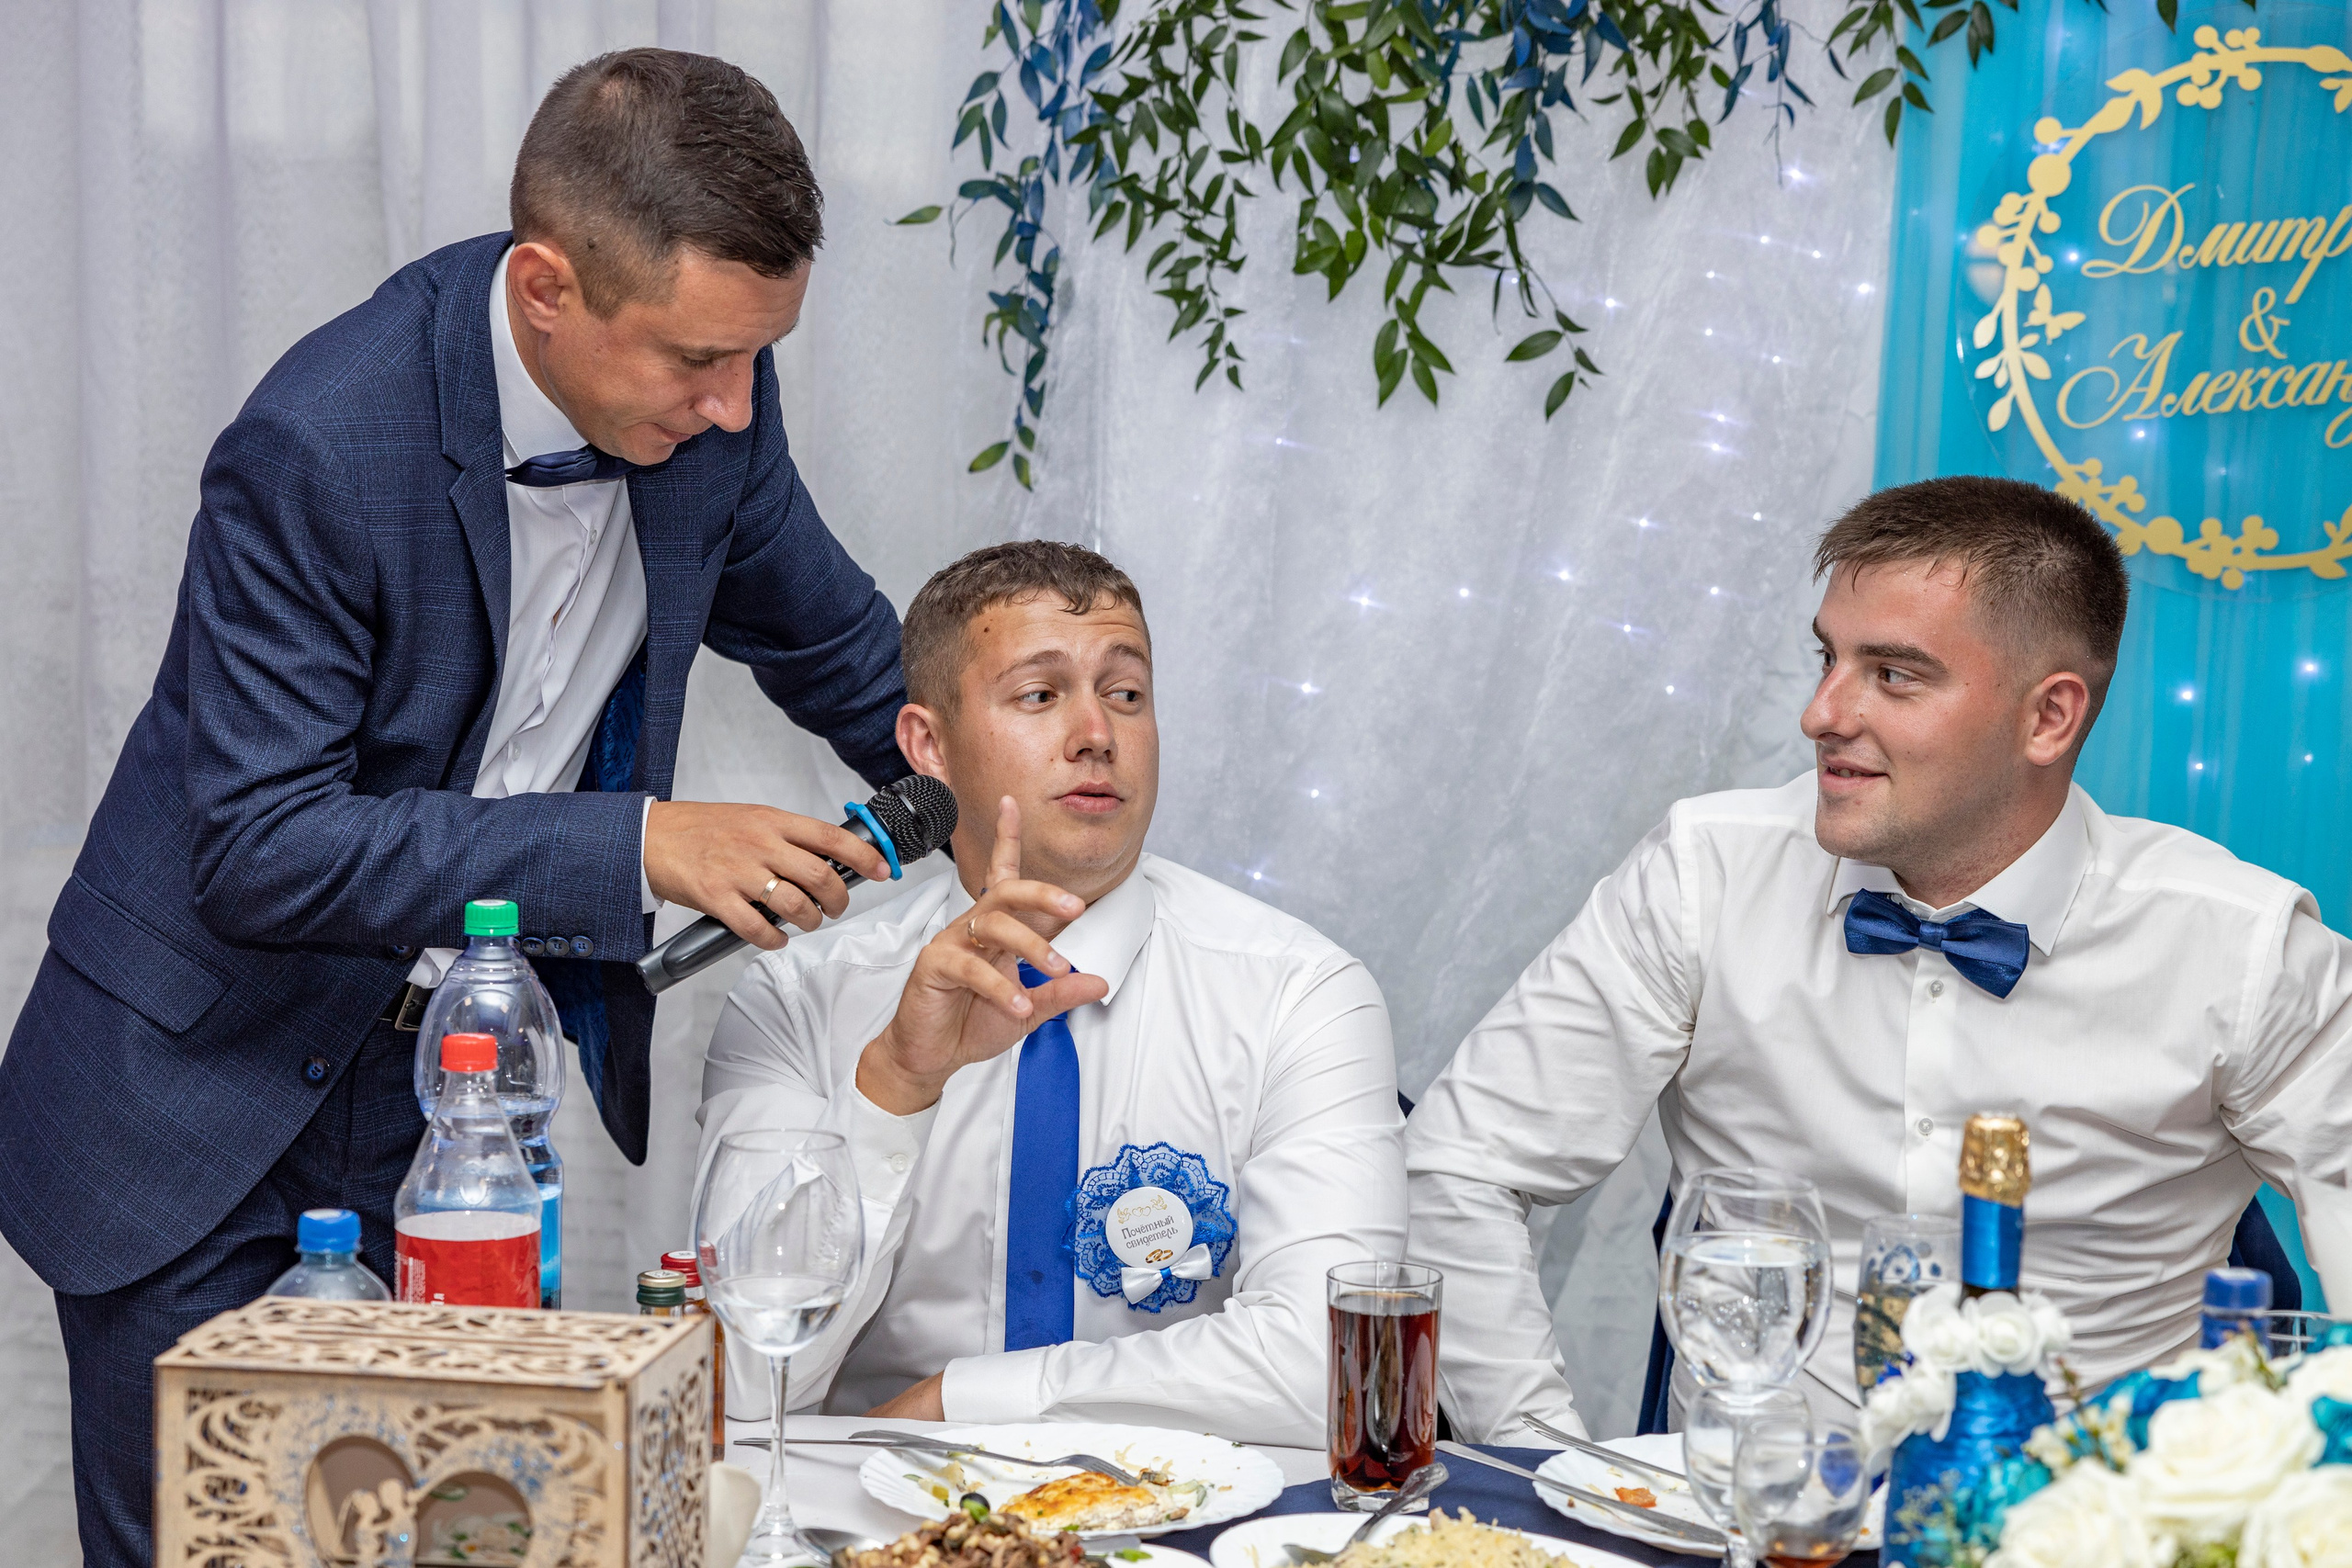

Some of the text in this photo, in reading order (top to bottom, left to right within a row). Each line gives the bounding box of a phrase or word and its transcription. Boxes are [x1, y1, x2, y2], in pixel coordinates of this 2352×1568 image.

[2239, 287, 2290, 359] &
[1121, 1215, 1174, 1239] Почётный
[1125, 1226, 1179, 1249] свидетель
